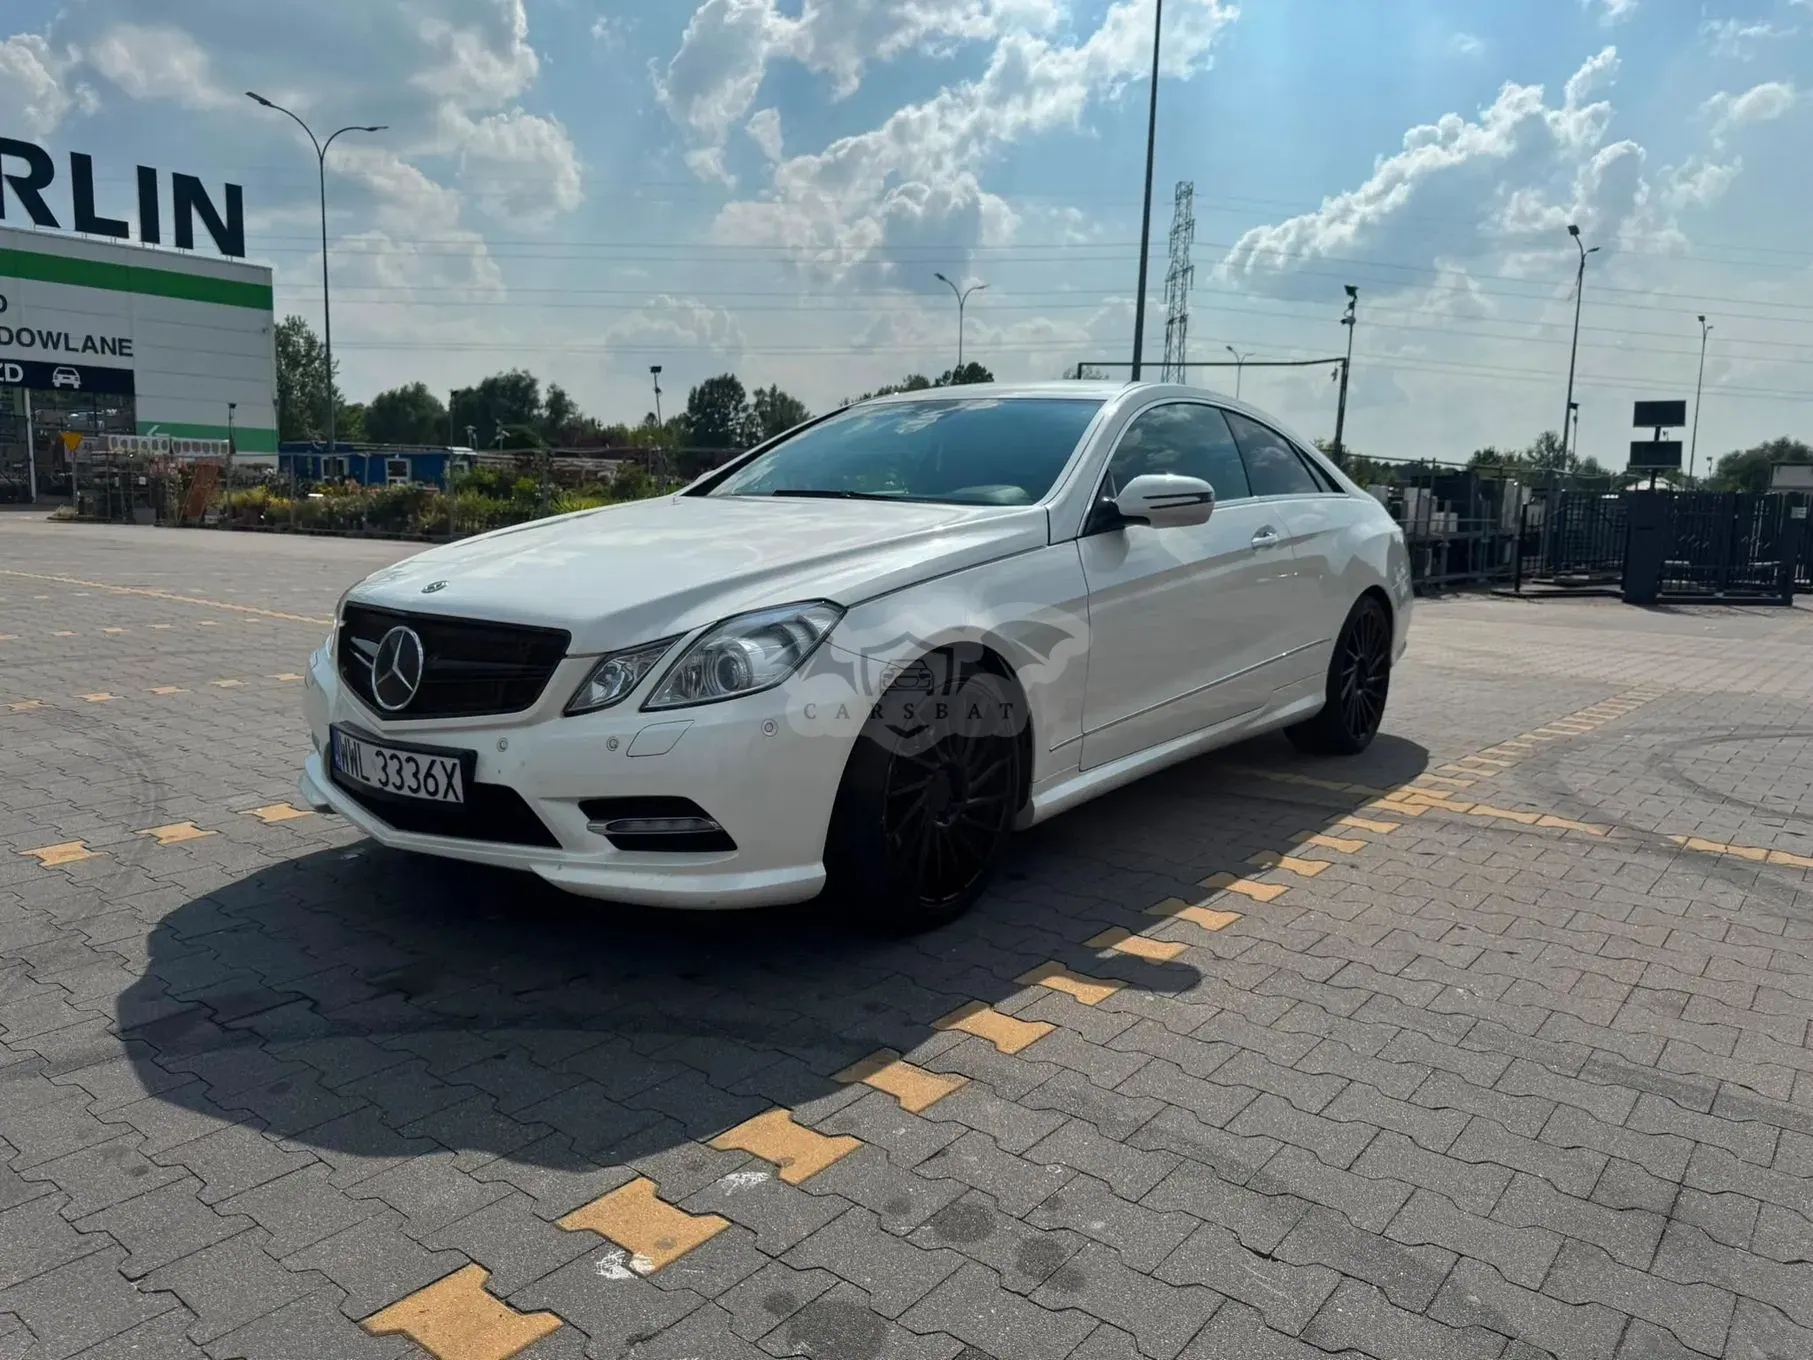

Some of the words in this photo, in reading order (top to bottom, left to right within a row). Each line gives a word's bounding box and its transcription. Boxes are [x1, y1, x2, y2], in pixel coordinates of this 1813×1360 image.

[0, 137, 246, 258] RLIN
[0, 325, 134, 358] DOWLANE
[375, 750, 461, 801] 3336X
